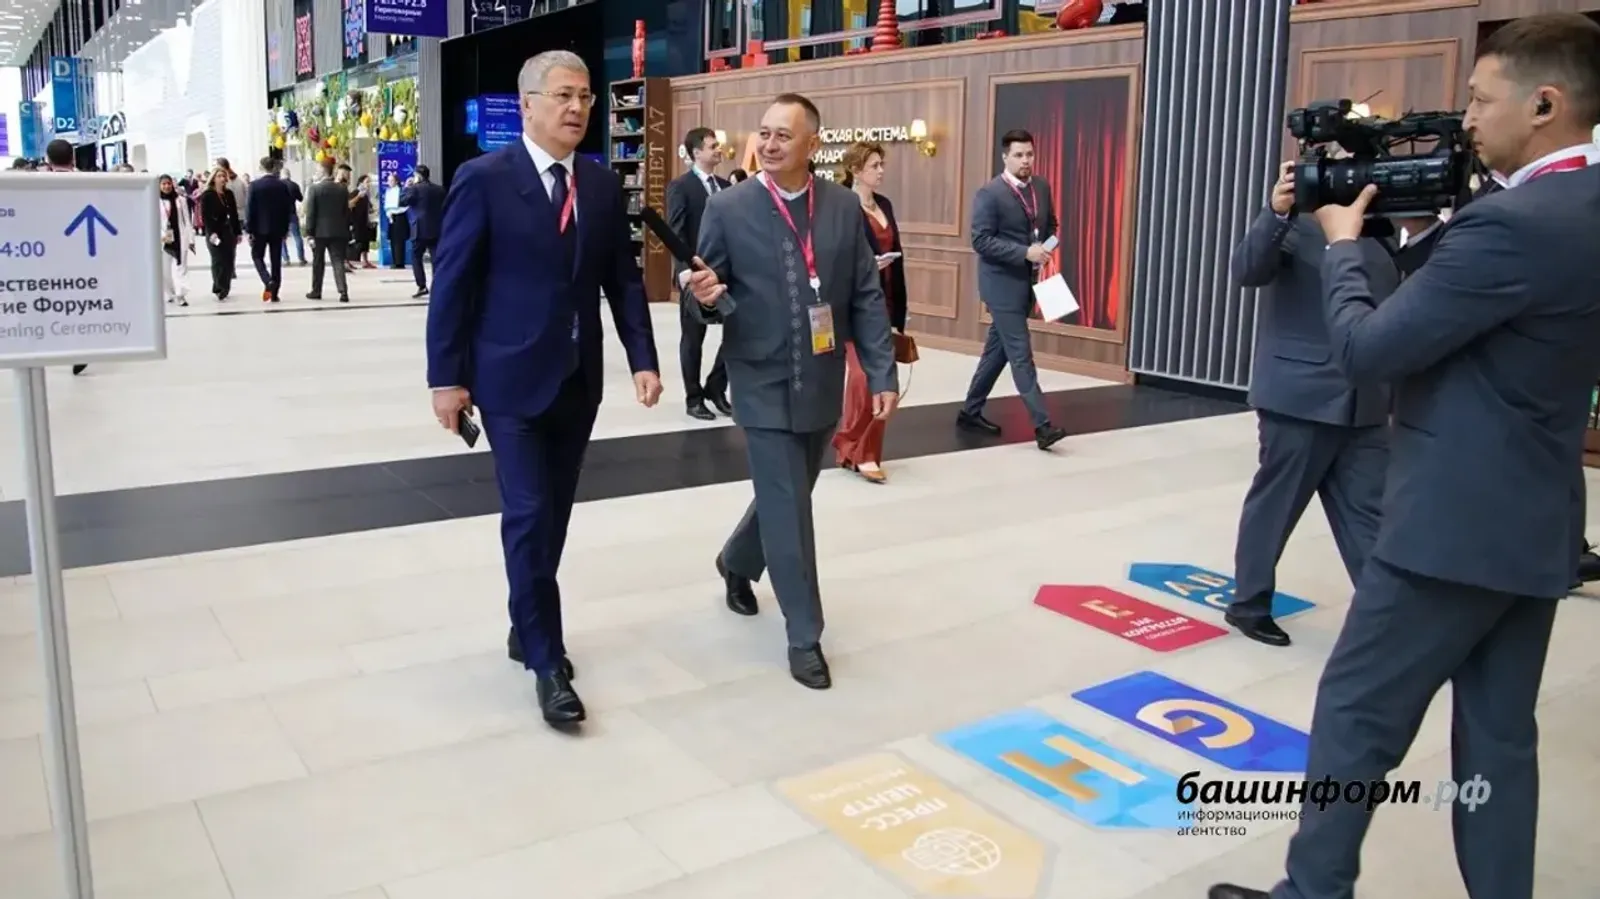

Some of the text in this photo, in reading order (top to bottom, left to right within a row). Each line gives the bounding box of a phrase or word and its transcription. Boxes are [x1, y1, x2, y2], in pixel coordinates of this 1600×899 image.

[55, 61, 71, 76] D
[57, 117, 75, 129] D2
[854, 125, 908, 142] СИСТЕМА
[381, 160, 399, 169] F20
[650, 142, 665, 254] КИНЕТ
[0, 277, 98, 292] ественное
[33, 297, 114, 316] Форума
[50, 319, 132, 336] Ceremony
[1135, 699, 1255, 750] G
[1000, 734, 1148, 803] H
[842, 783, 922, 817] ЦЕНТР
[860, 798, 948, 831] ПРЕСС-
